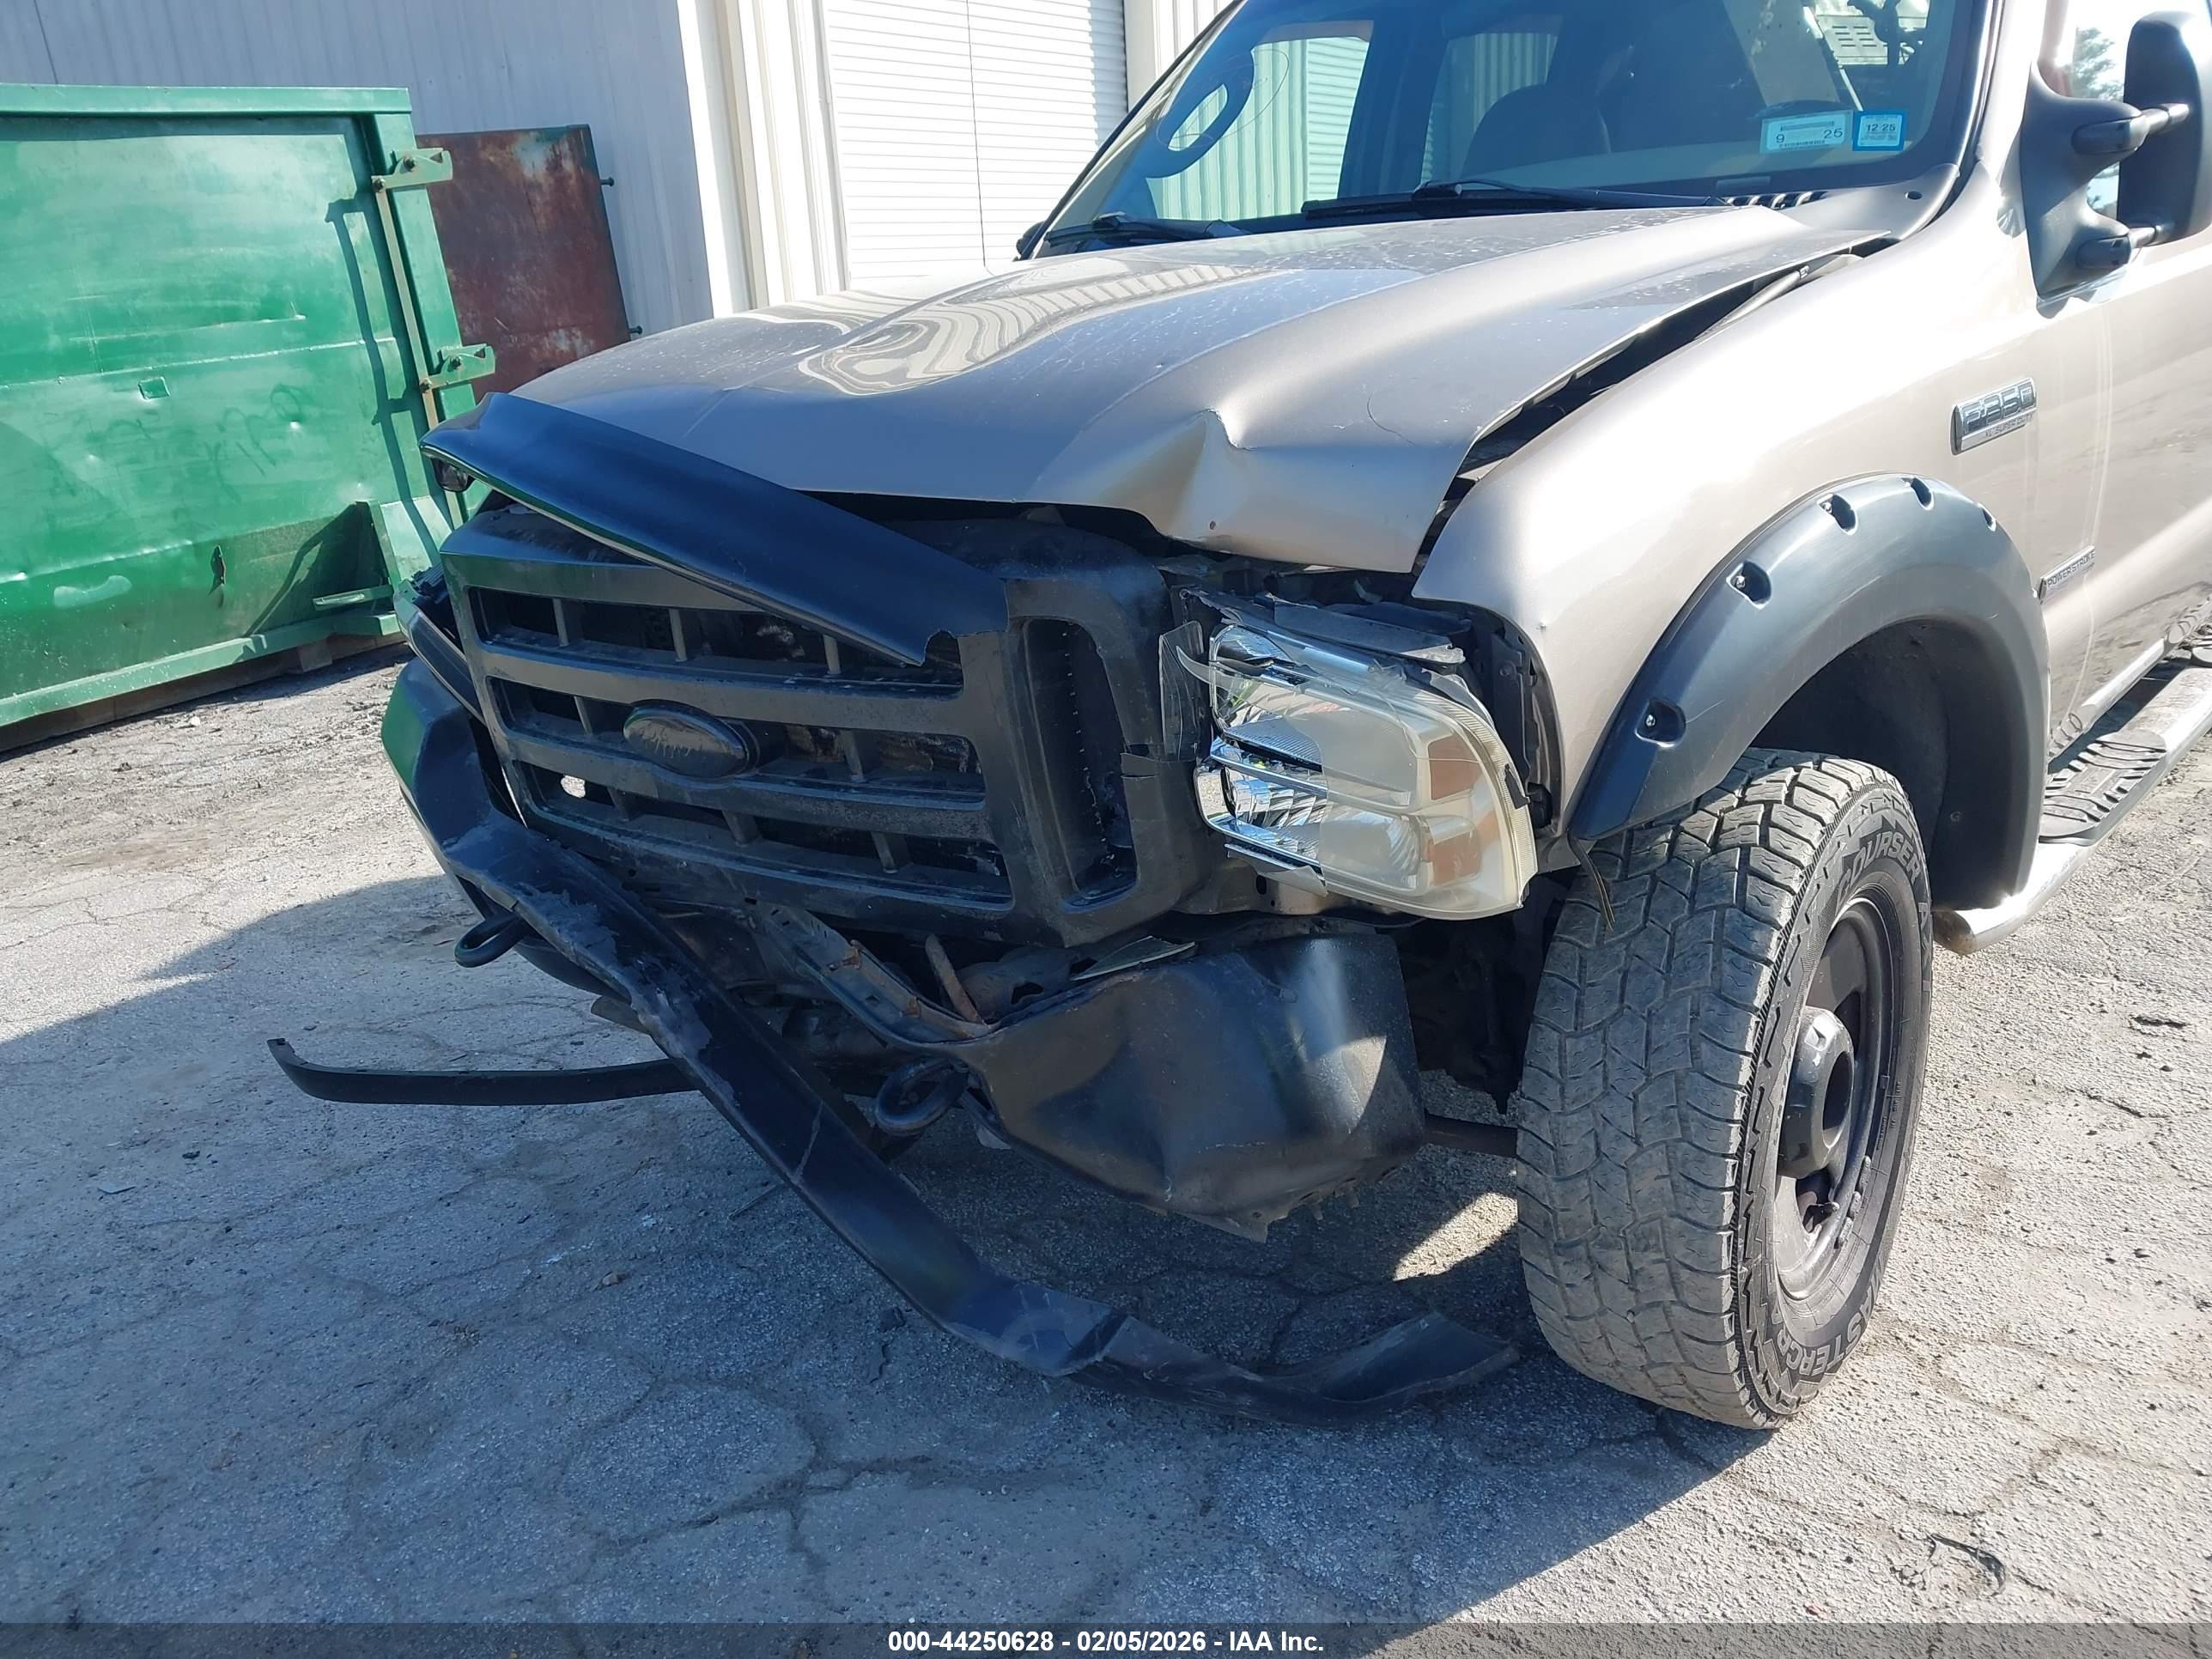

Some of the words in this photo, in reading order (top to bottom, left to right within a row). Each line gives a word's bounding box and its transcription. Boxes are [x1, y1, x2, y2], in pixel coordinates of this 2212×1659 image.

[1867, 123, 1879, 131] 12
[1881, 123, 1896, 131] 25
[1776, 133, 1785, 143] 9
[1823, 128, 1844, 139] 25
[1834, 830, 1922, 917] COURSER
